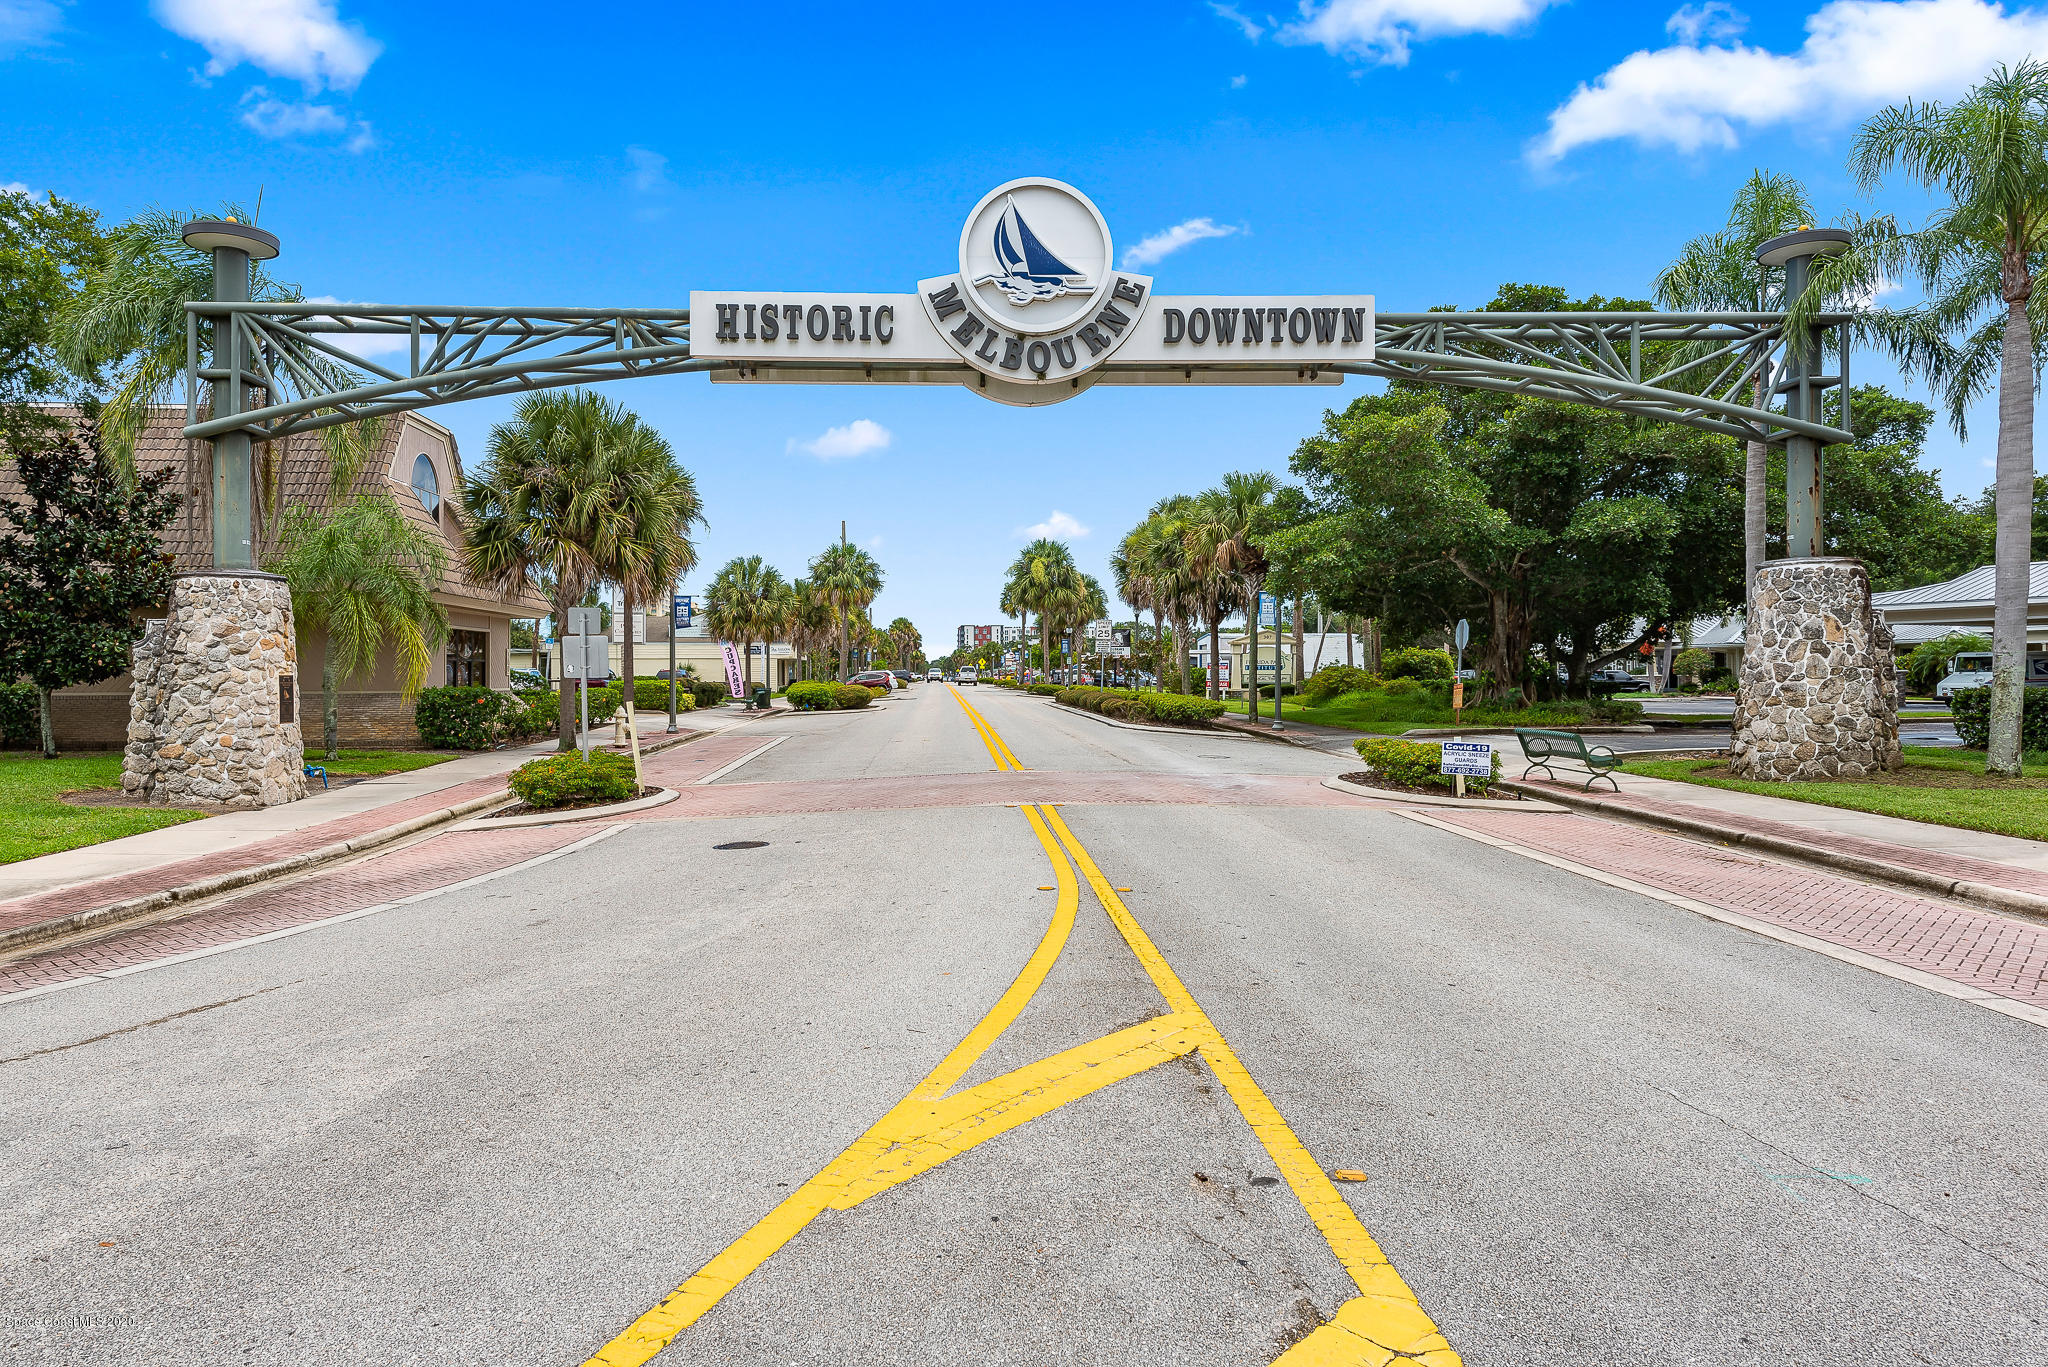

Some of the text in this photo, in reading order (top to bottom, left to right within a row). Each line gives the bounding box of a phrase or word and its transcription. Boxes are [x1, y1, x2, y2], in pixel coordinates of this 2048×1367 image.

[716, 304, 894, 342] HISTORIC
[928, 277, 1145, 373] MELBOURNE
[1163, 307, 1366, 344] DOWNTOWN
[1446, 744, 1488, 752] Covid-19
[1444, 767, 1488, 775] 877-692-2738
